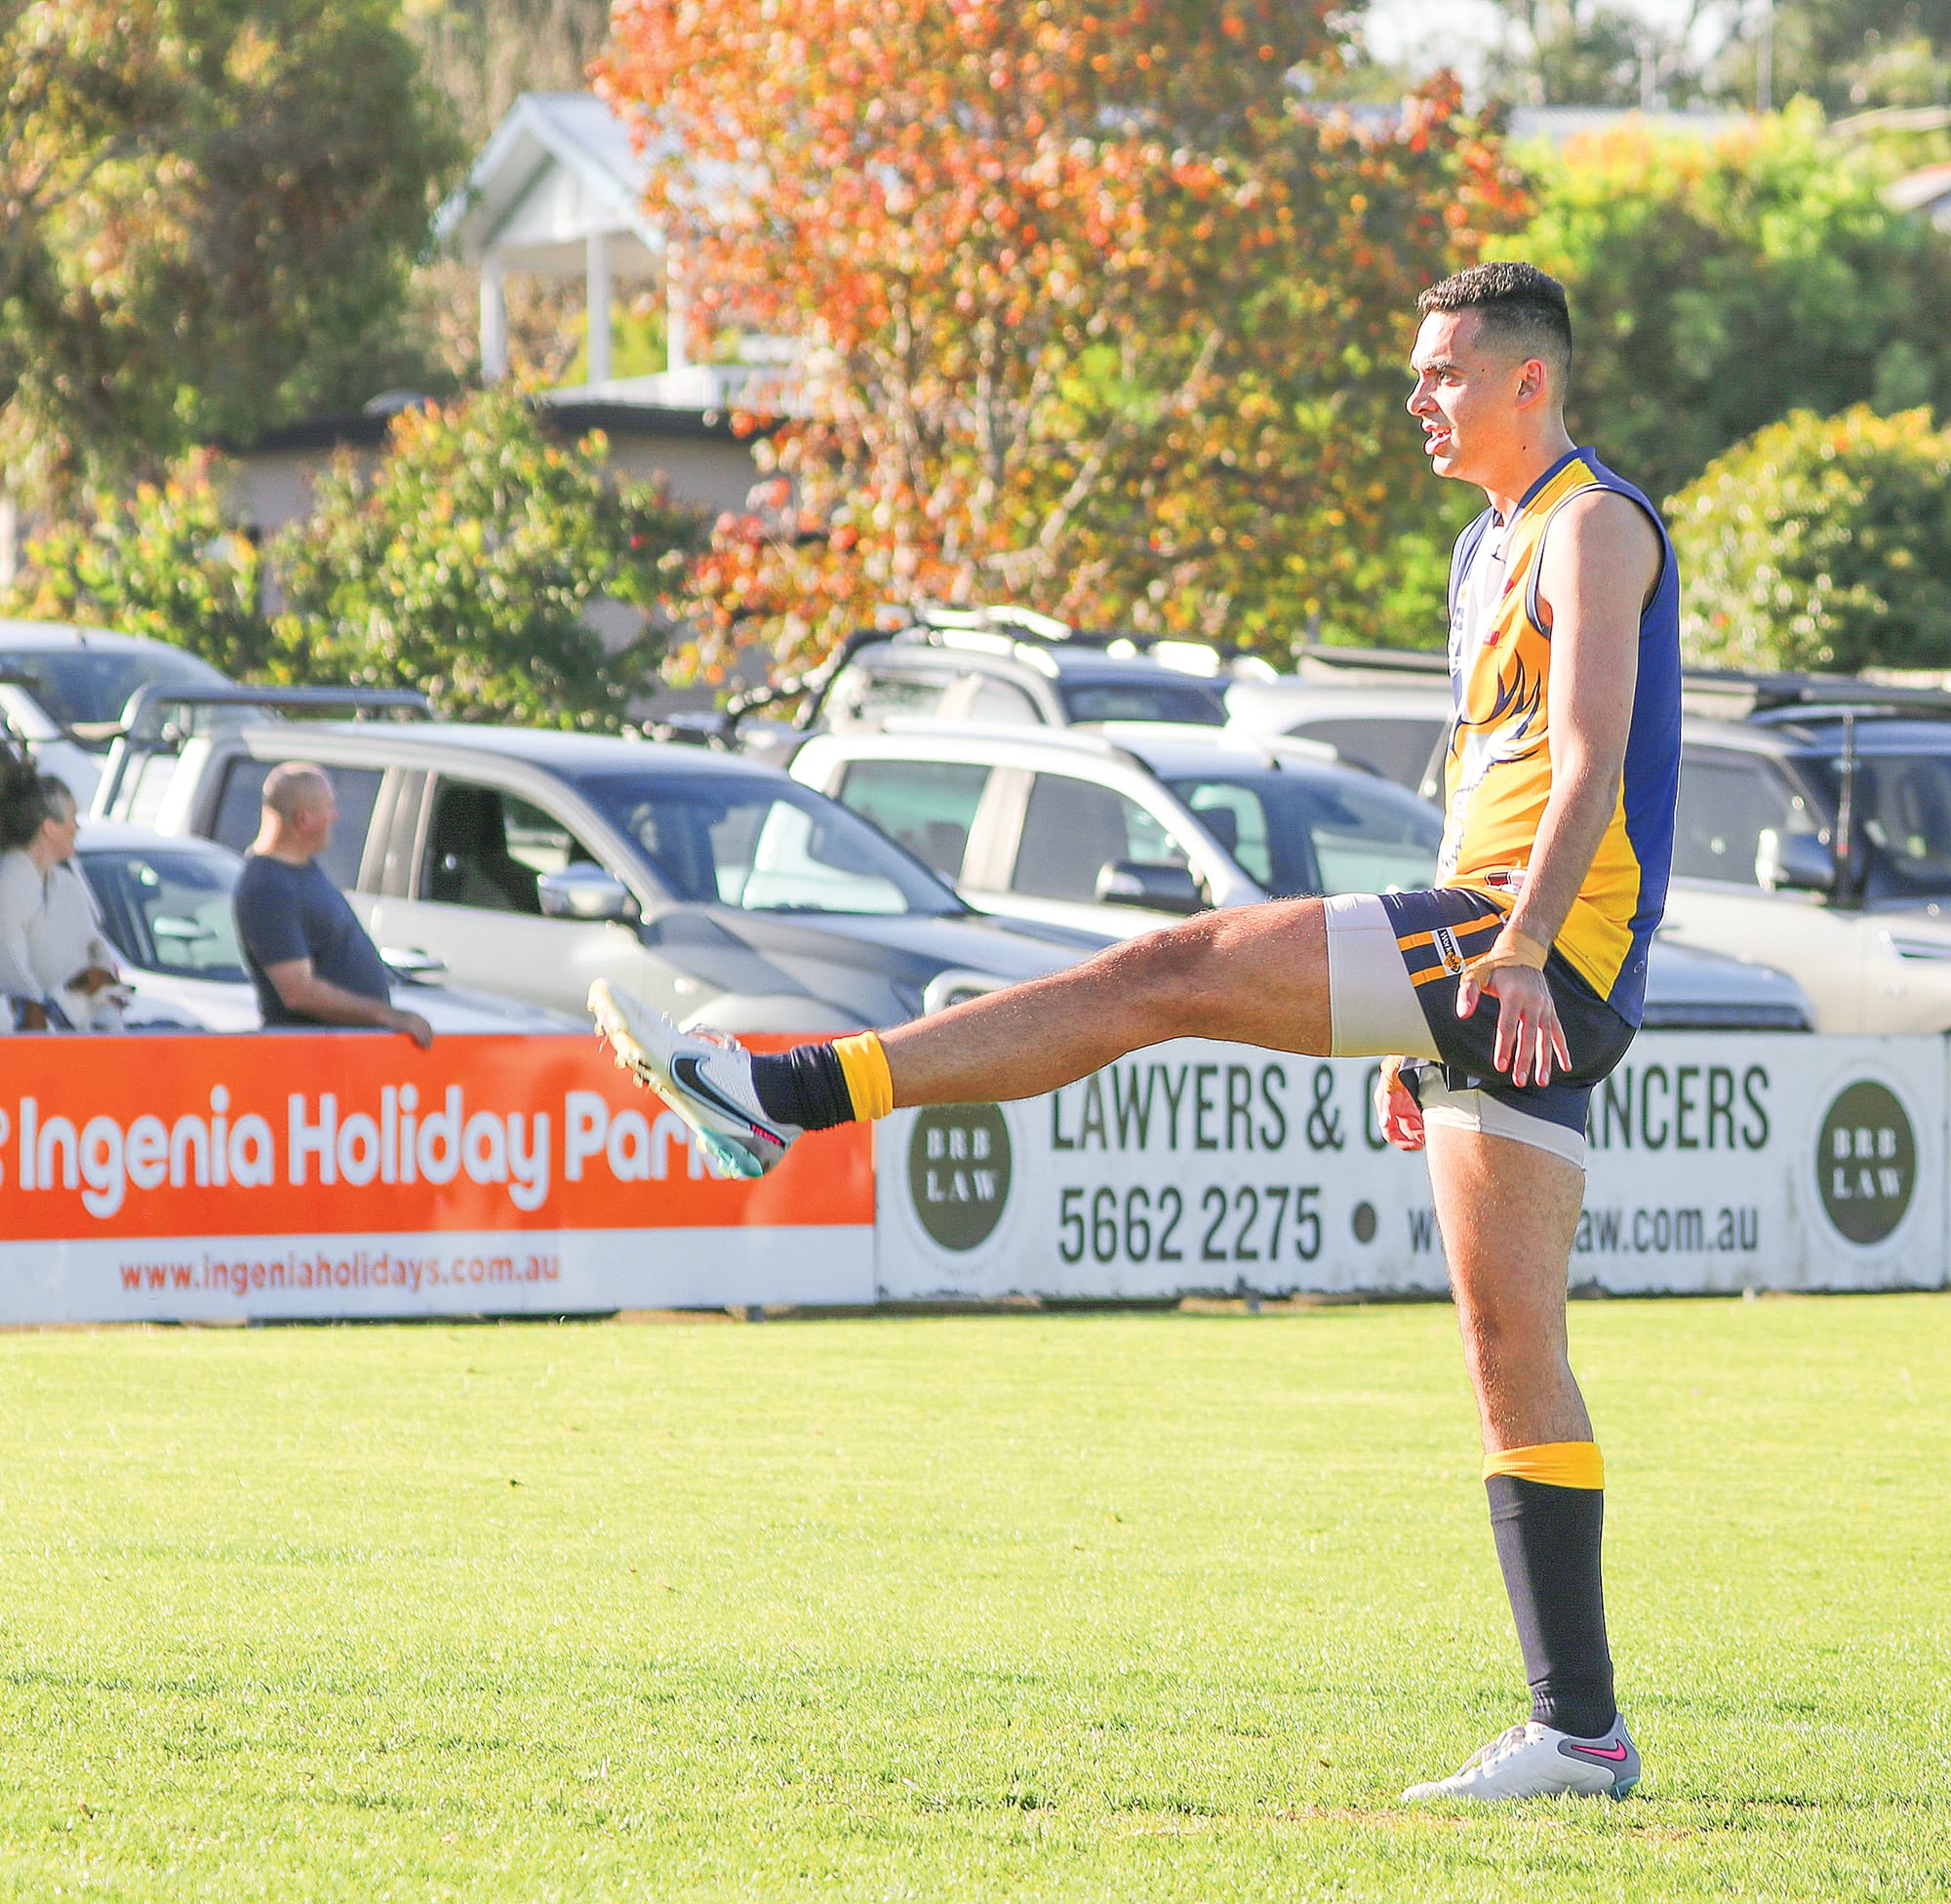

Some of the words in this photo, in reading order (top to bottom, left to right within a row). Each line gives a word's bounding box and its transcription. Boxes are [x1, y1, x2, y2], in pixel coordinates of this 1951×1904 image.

[1051, 1063, 1286, 1149] LAWYERS
[1307, 1064, 1343, 1149] &
[20, 1084, 273, 1218] Ingenia
[289, 1083, 550, 1210] Holiday
[928, 1128, 991, 1160] BRB
[1833, 1127, 1896, 1159] BRB
[928, 1170, 998, 1202] LAW
[1833, 1168, 1900, 1199] LAW
[1059, 1187, 1182, 1262] 5662
[1202, 1186, 1321, 1261] 2275
[120, 1253, 559, 1296] www.ingeniaholidays.com.au
